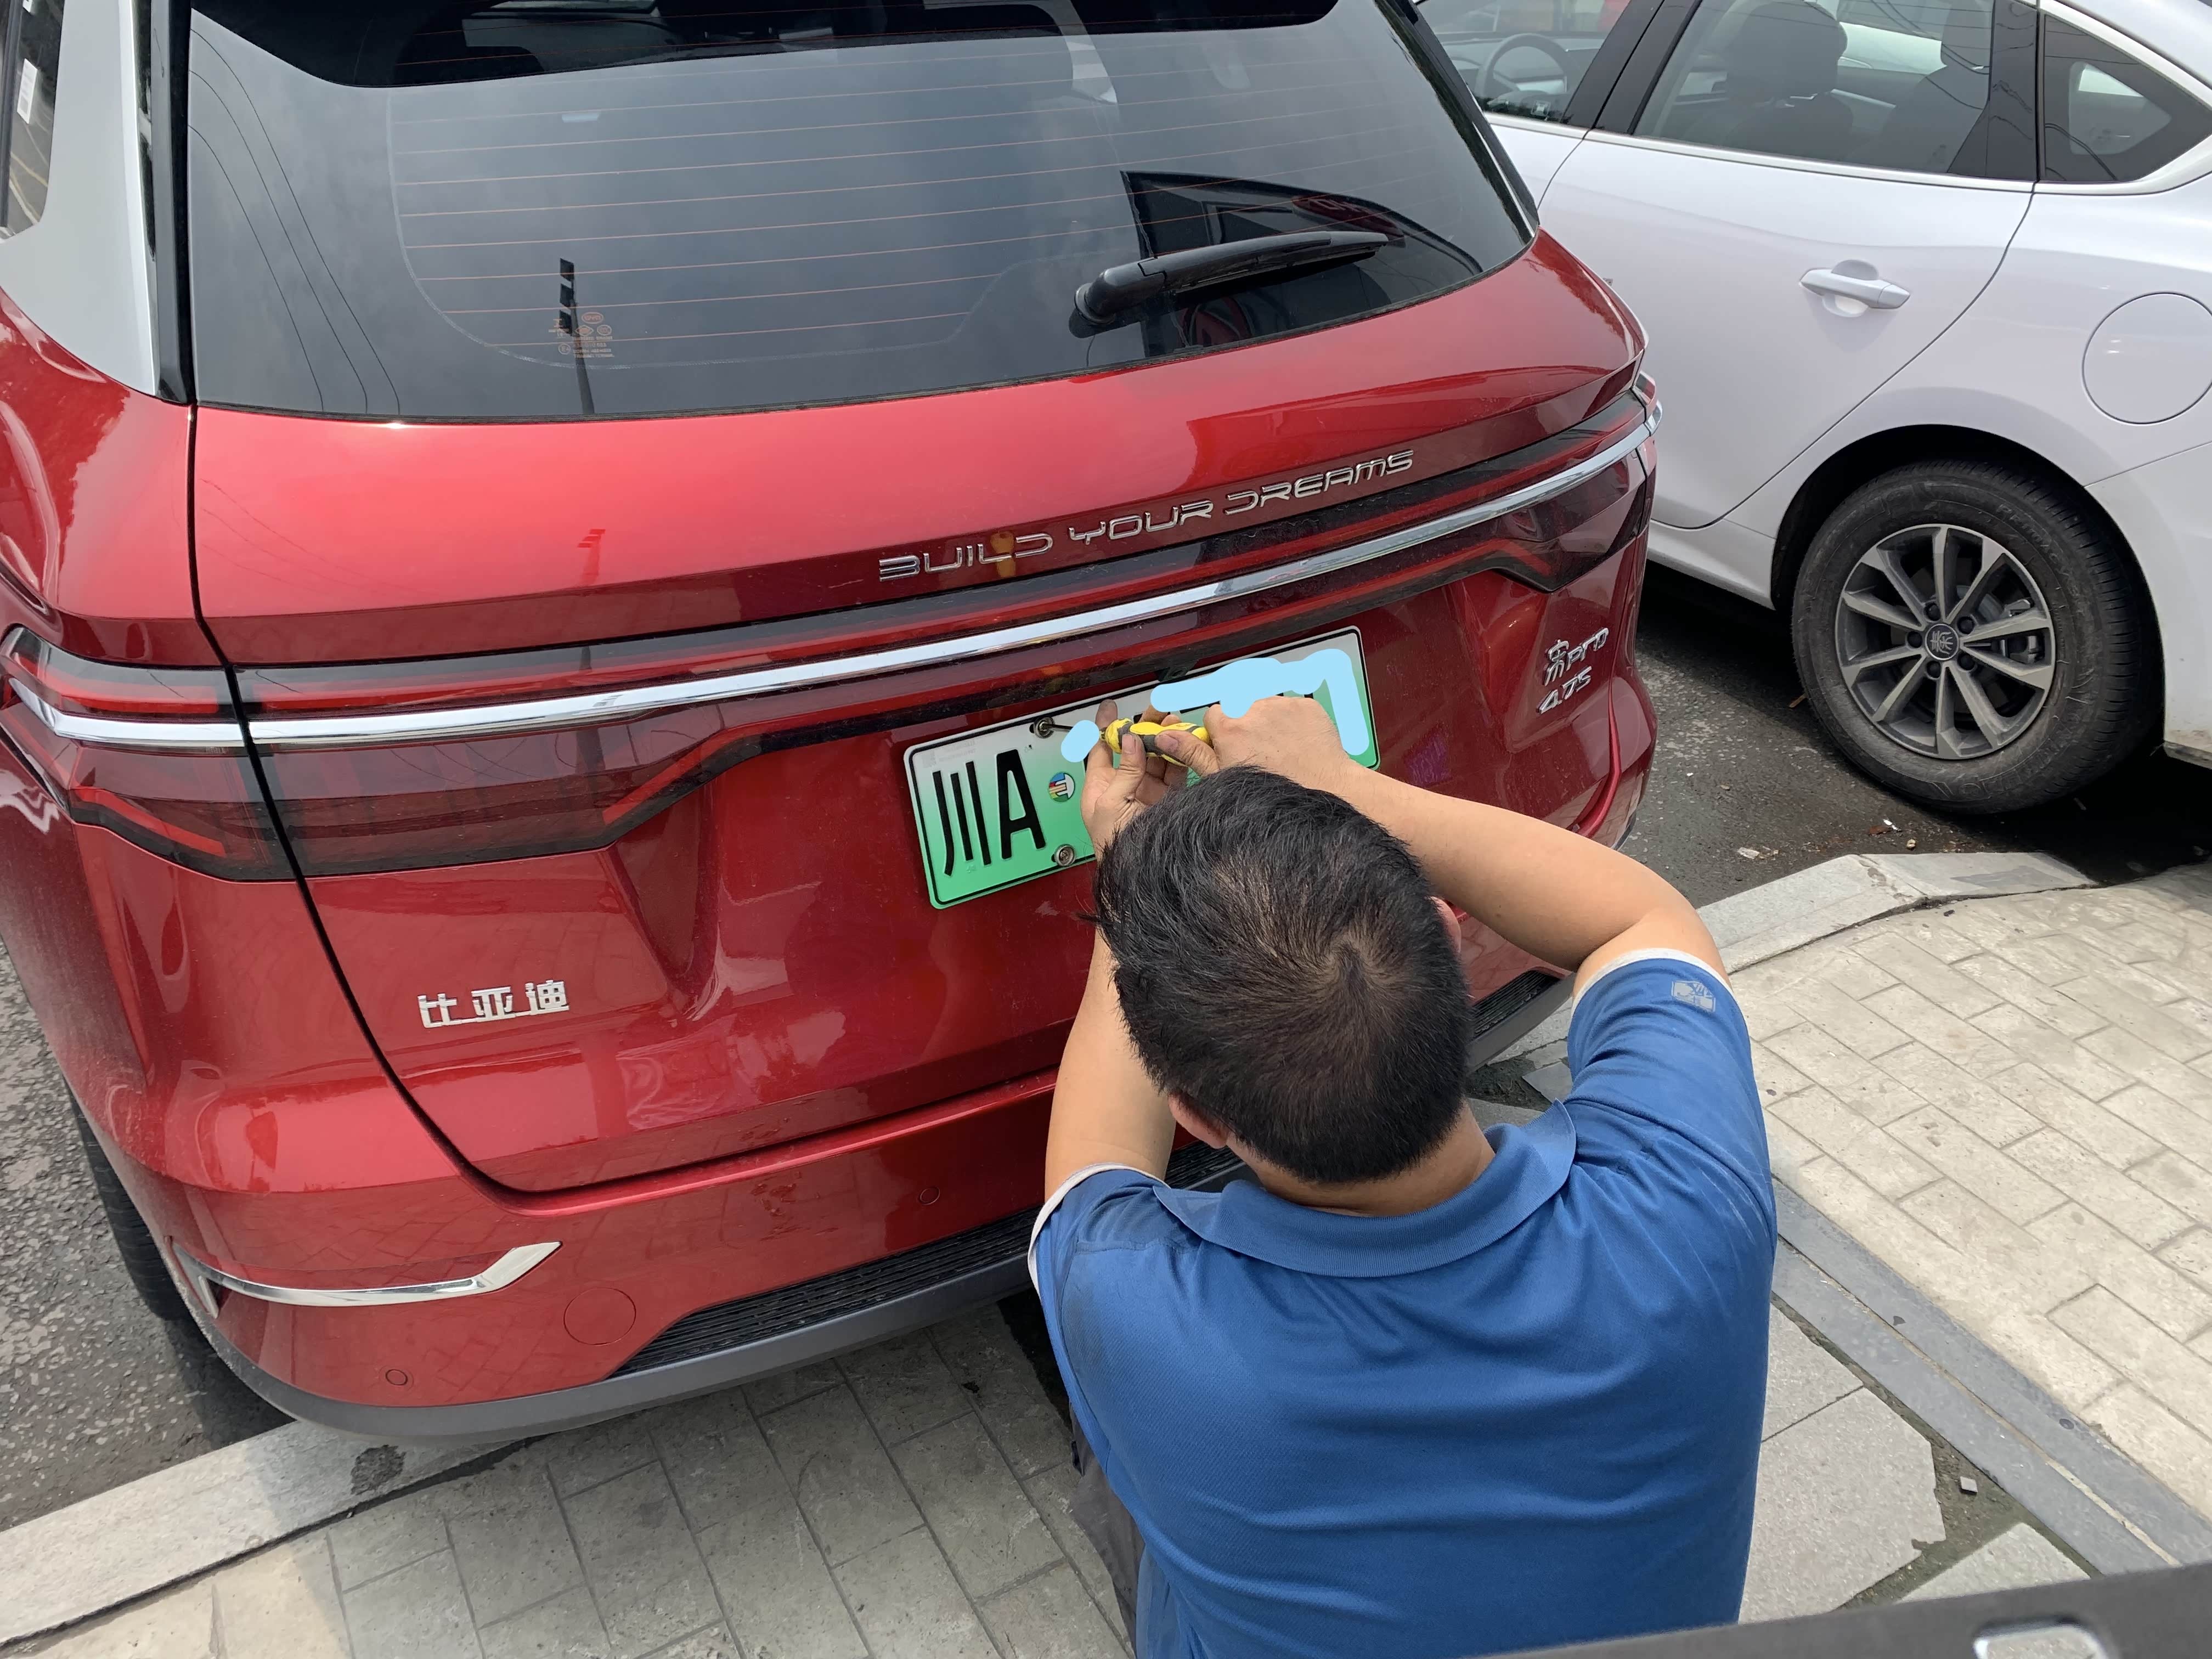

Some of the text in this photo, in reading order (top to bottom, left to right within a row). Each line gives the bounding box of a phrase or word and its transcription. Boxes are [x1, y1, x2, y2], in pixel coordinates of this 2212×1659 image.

[878, 449, 1414, 582] BUILD YOUR DREAMS
[417, 980, 570, 1028] 比亚迪
